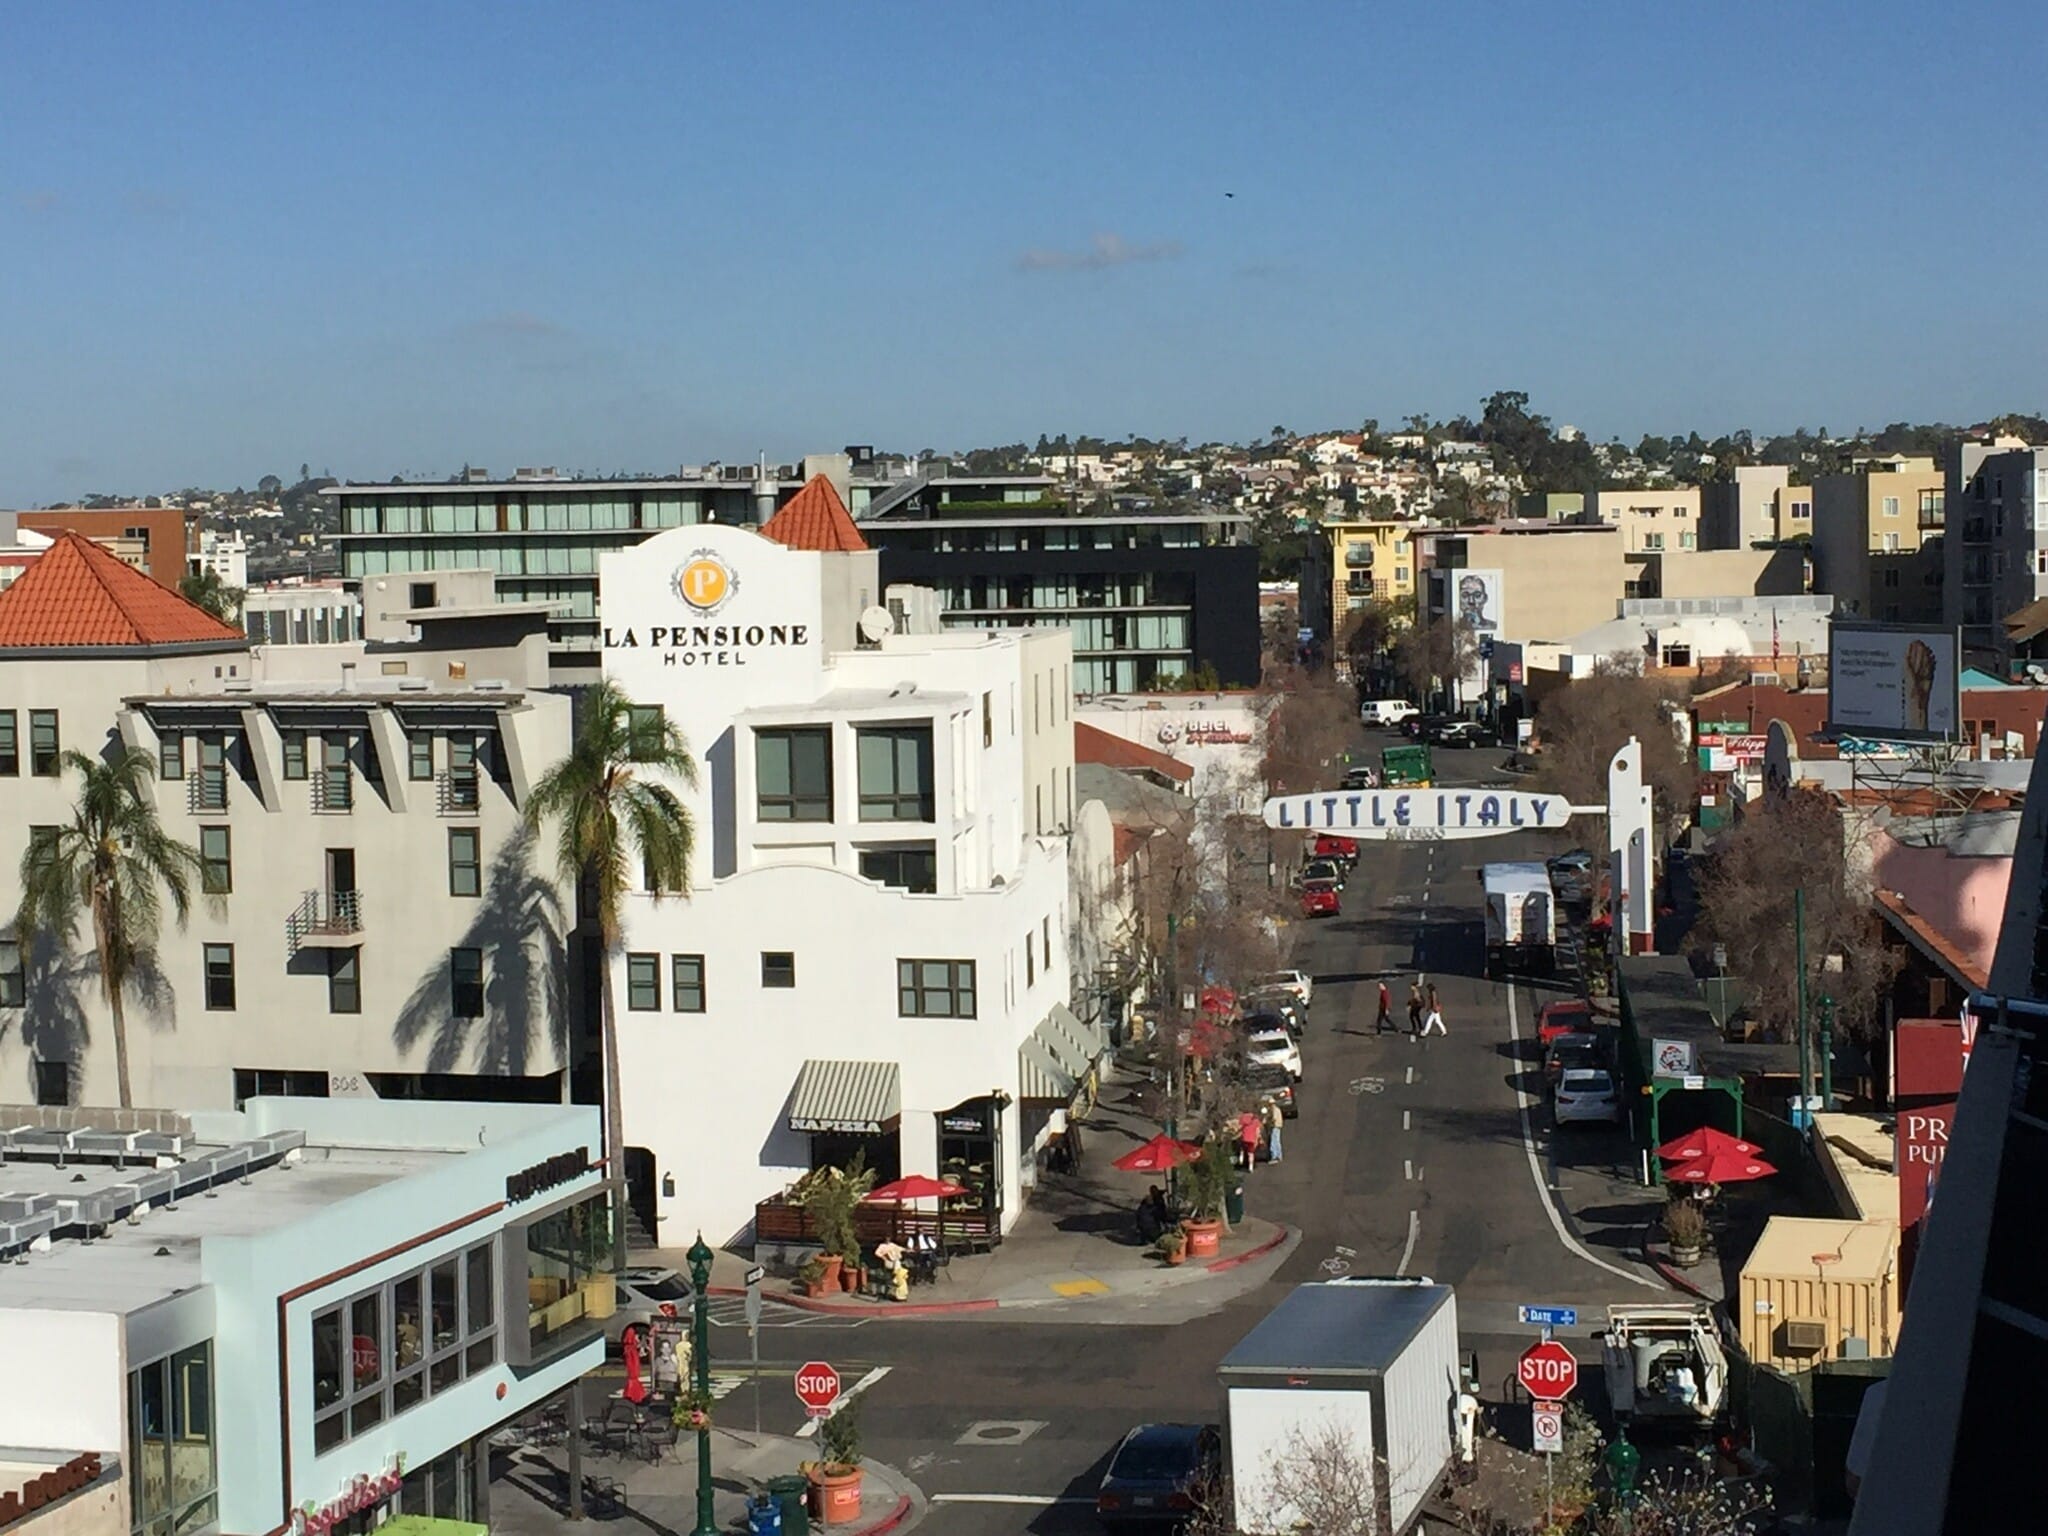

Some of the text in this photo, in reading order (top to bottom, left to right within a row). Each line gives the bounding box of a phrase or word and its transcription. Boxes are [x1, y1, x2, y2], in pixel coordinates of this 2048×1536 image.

[692, 569, 718, 598] P
[604, 625, 808, 648] LA PENSIONE
[663, 651, 746, 666] HOTEL
[1278, 794, 1550, 828] LITTLE ITALY
[790, 1118, 882, 1133] NAPIZZA
[1522, 1357, 1573, 1383] STOP
[799, 1375, 837, 1394] STOP
